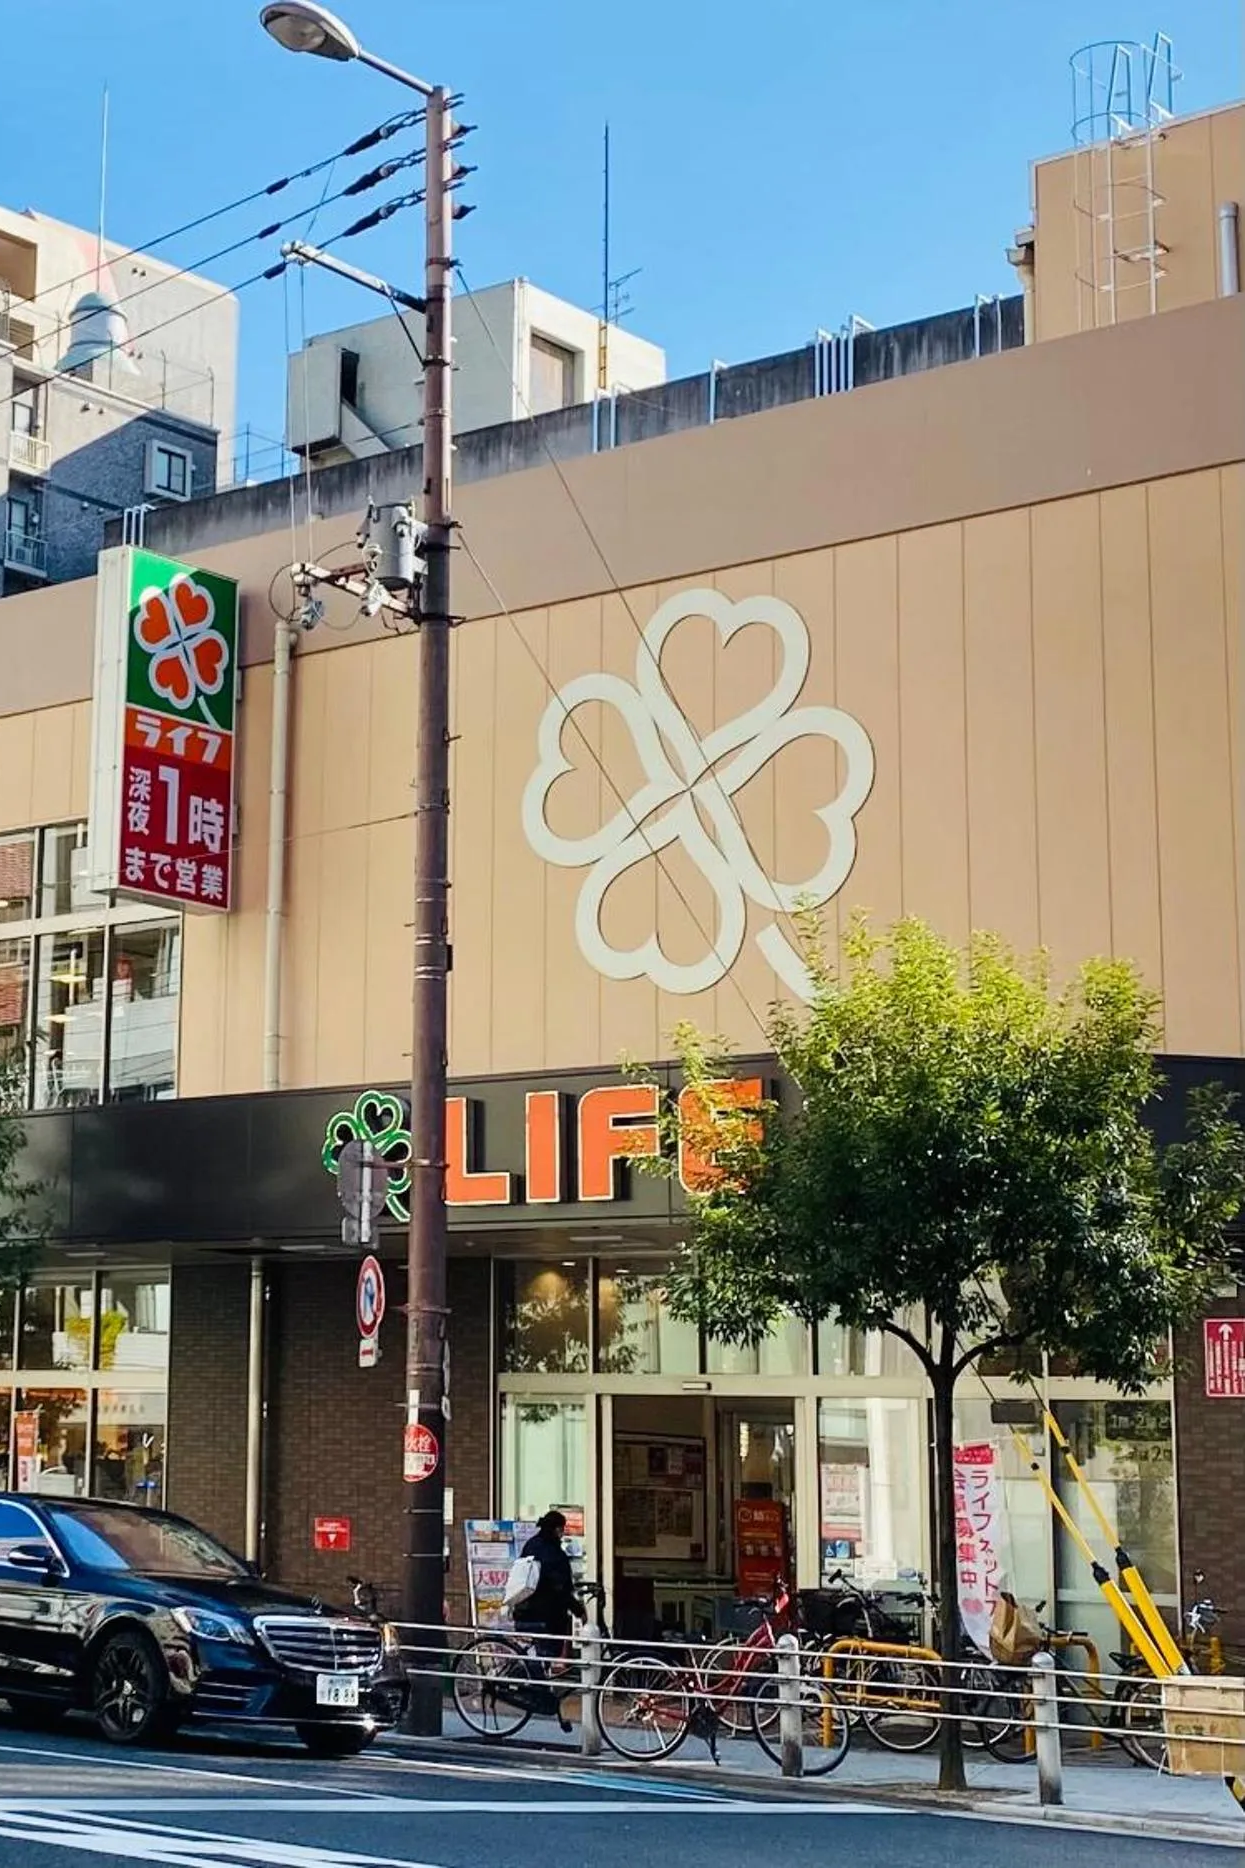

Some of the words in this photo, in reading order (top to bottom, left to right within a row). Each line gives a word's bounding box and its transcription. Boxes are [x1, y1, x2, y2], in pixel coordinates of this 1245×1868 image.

[135, 713, 222, 764] ライフ
[128, 766, 152, 836] 深夜
[158, 765, 224, 854] 1時
[125, 847, 223, 900] まで営業
[444, 1077, 763, 1206] LIFE
